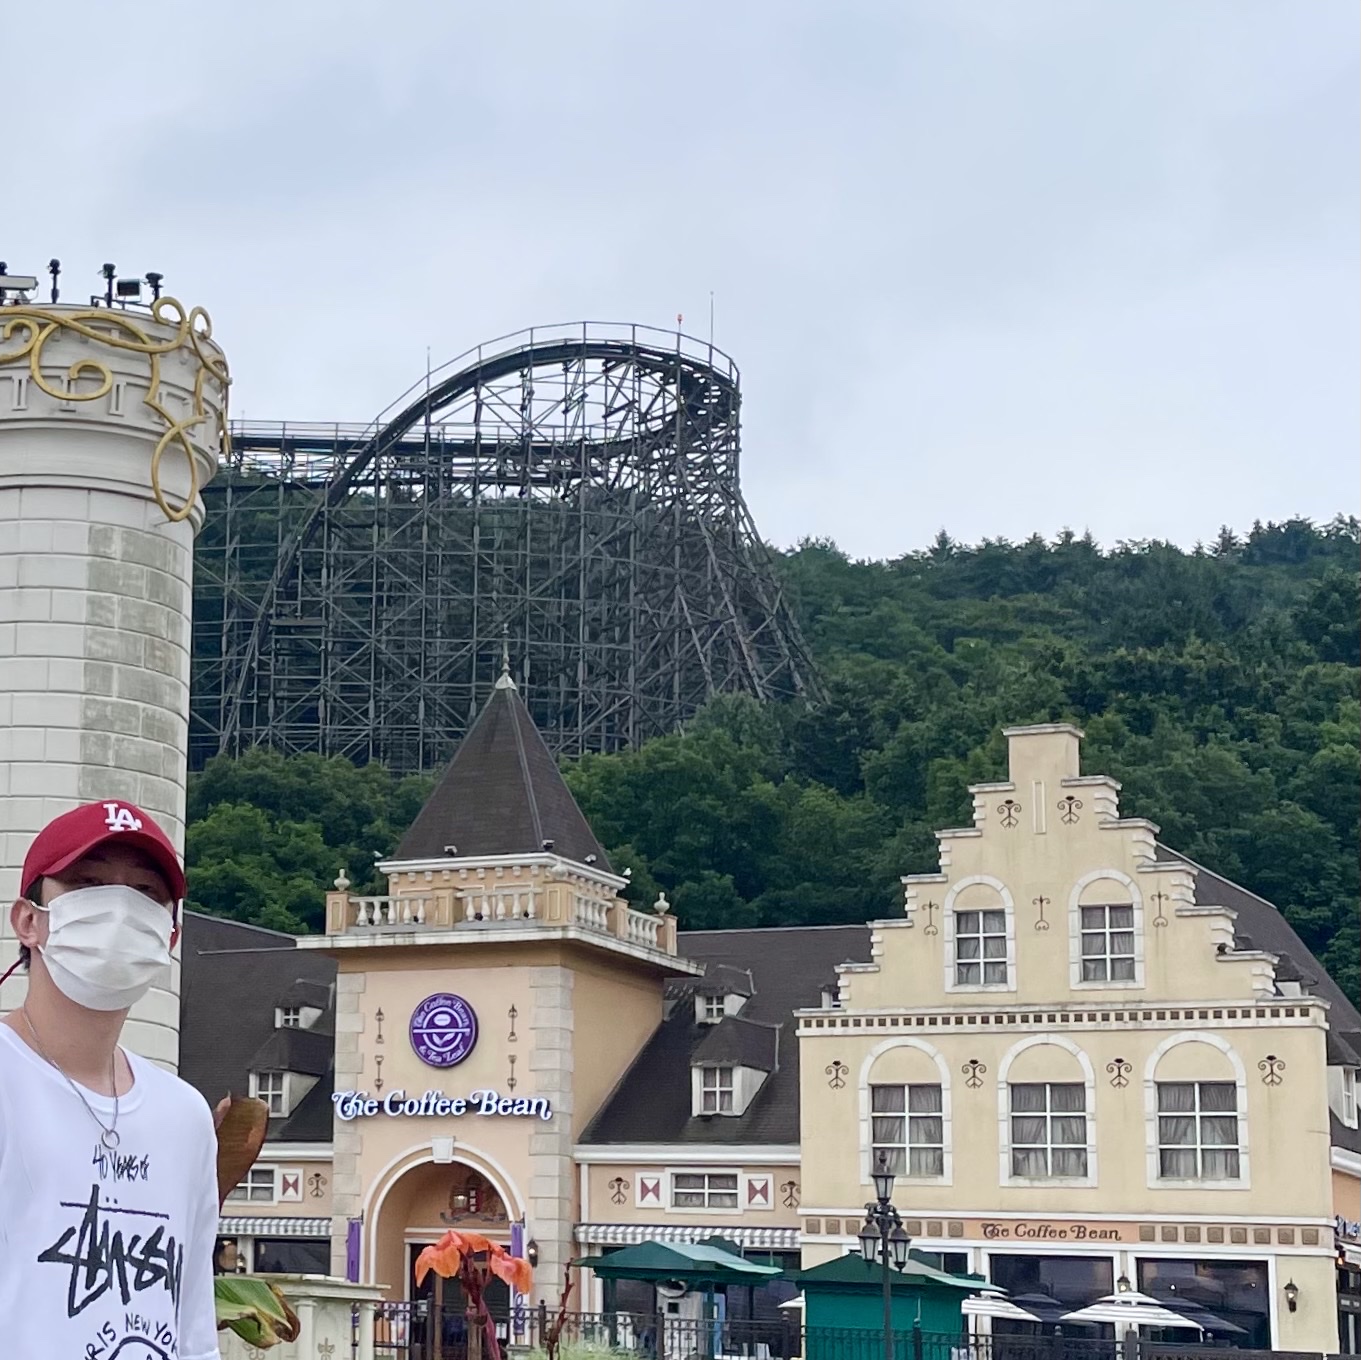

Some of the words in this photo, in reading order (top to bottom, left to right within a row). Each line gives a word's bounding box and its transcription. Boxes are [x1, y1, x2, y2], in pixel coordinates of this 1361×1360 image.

[103, 803, 142, 832] LA
[331, 1090, 378, 1121] The
[383, 1089, 467, 1118] Coffee
[470, 1089, 553, 1121] Bean
[981, 1223, 1010, 1240] The
[1014, 1223, 1067, 1239] Coffee
[1070, 1224, 1122, 1241] Bean
[125, 1312, 151, 1336] NEW
